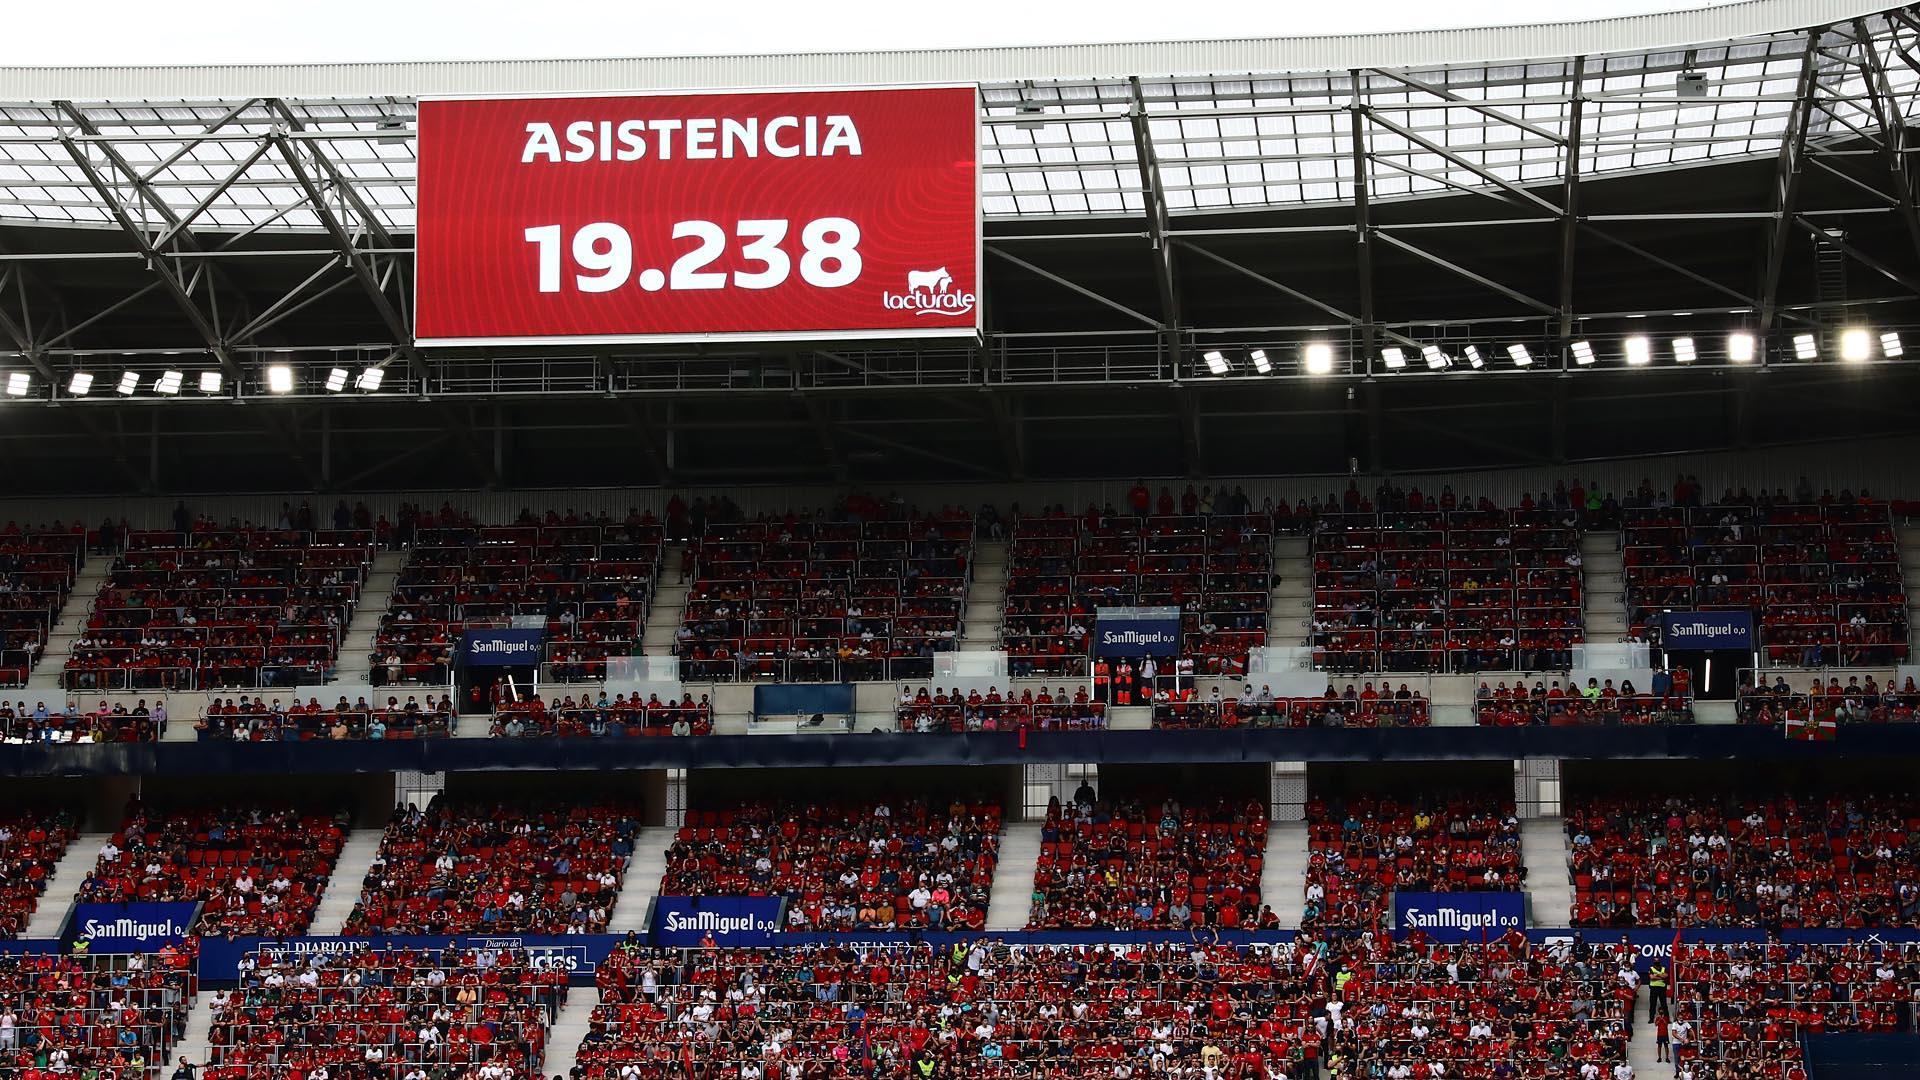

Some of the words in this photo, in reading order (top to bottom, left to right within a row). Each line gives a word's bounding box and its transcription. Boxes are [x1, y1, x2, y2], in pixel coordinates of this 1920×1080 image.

[521, 115, 863, 163] ASISTENCIA
[524, 217, 863, 293] 19.238
[883, 289, 976, 311] lacturale
[1103, 631, 1161, 645] SanMiguel
[1670, 623, 1732, 637] SanMiguel
[471, 639, 528, 654] SanMiguel
[84, 918, 171, 941] SanMiguel
[664, 911, 754, 934] SanMiguel
[1403, 908, 1497, 931] SanMiguel
